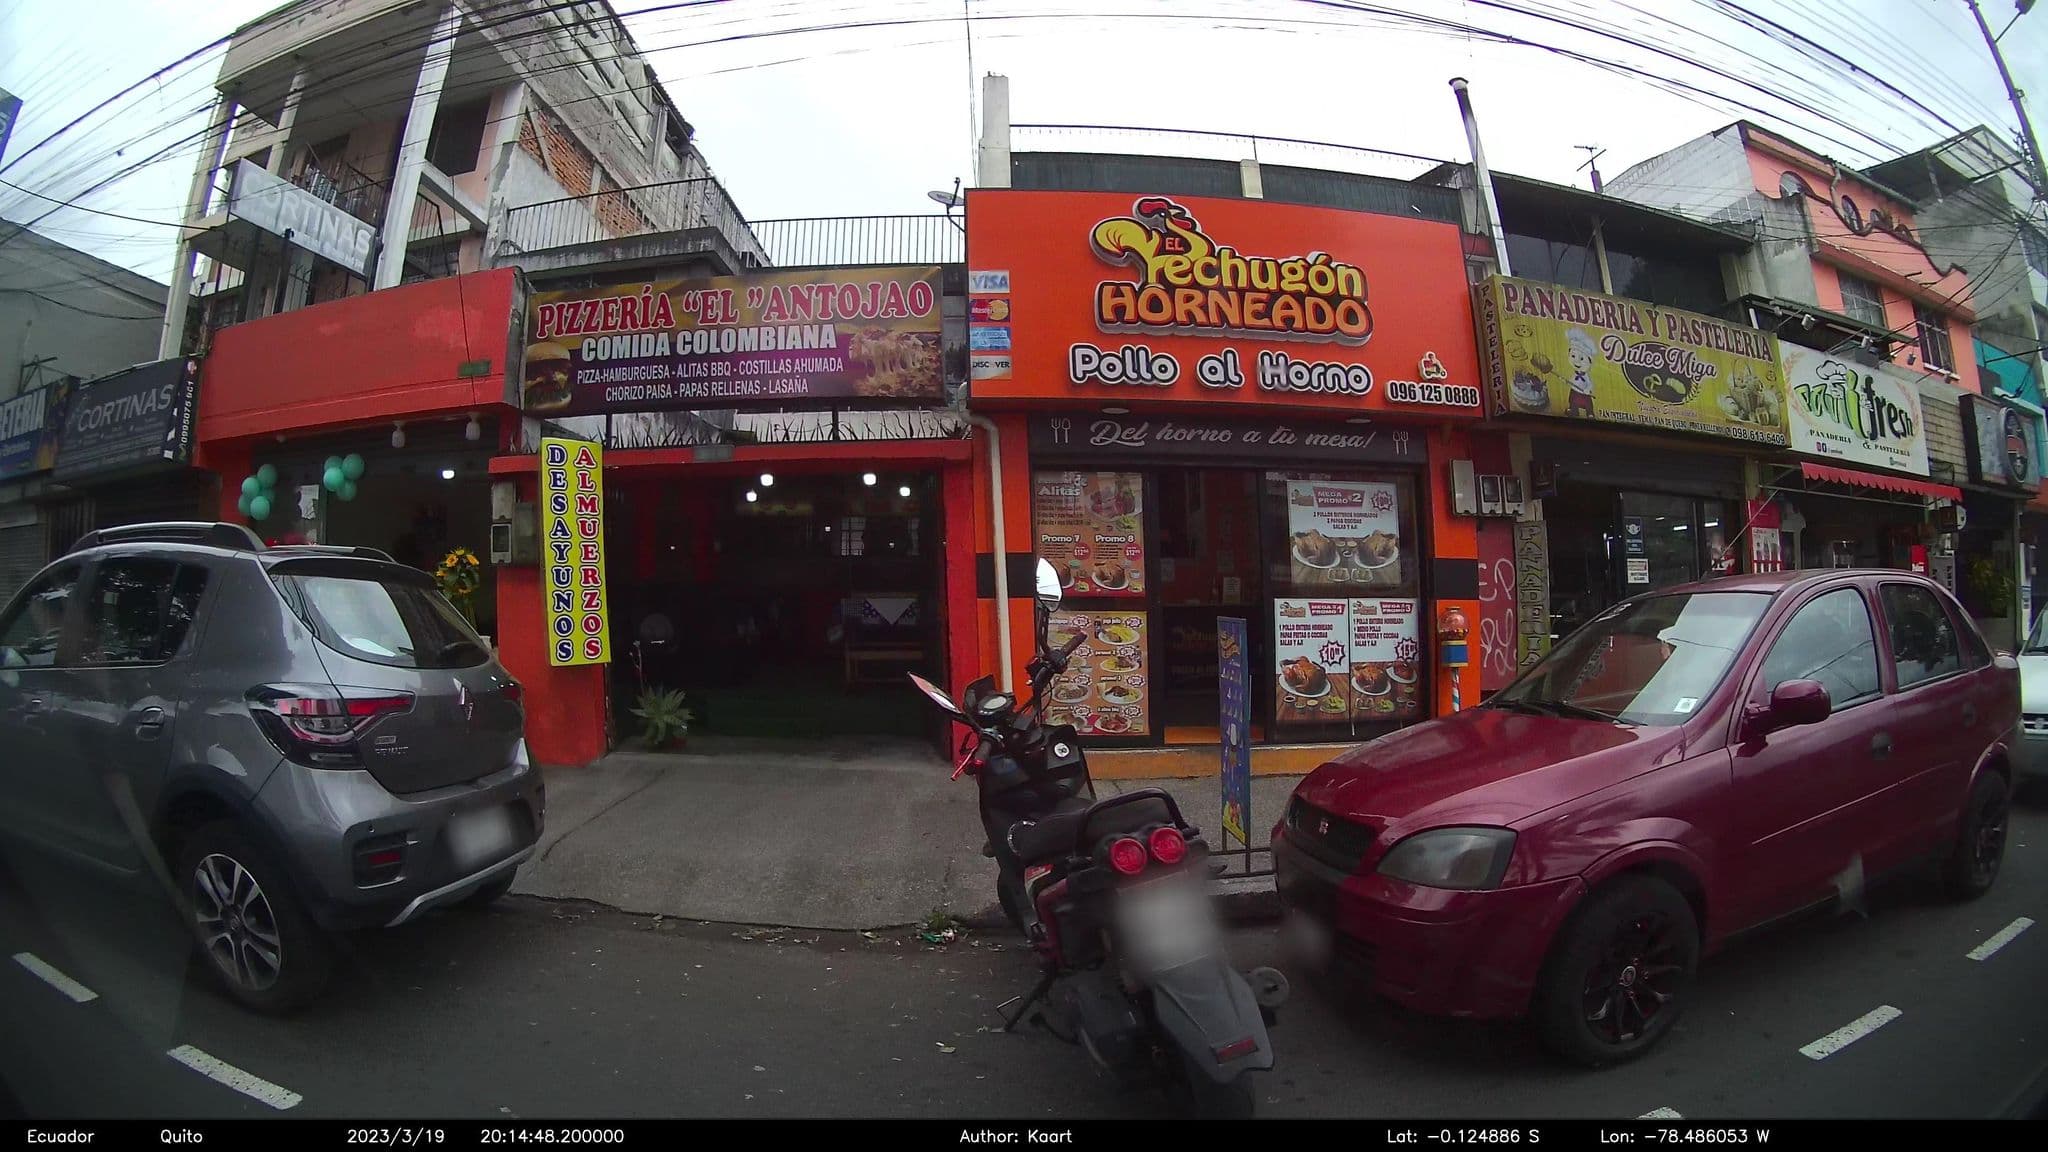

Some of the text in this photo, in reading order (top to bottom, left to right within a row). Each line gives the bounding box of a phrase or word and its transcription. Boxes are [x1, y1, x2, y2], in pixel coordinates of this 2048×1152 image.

[1165, 237, 1185, 251] EL
[971, 274, 1009, 289] VISA
[536, 284, 677, 338] PIZZERÍA
[1101, 284, 1369, 335] HORNEADO
[1501, 282, 1774, 363] PANADERIA Y PASTELERIA
[582, 324, 837, 361] COMIDA COLOMBIANA
[1480, 285, 1507, 415] PASTELERIA
[577, 365, 670, 384] PIZZA-HAMBURGUESA
[676, 362, 708, 378] ALITAS
[710, 361, 731, 377] BBQ
[739, 359, 791, 375] COSTILLAS
[794, 357, 843, 373] AHUMADA
[1072, 344, 1372, 393] Pollo al Horno
[1601, 335, 1718, 381] Dulce Miga
[606, 385, 644, 401] CHORIZO
[648, 383, 672, 399] PAISA
[679, 381, 708, 397] PAPAS
[711, 379, 760, 395] RELLENAS
[769, 375, 808, 394] LASAÑA
[1389, 383, 1478, 405] 096 125 0888
[77, 383, 175, 432] CORTINAS
[1090, 421, 1149, 446] Del
[1156, 422, 1232, 442] horno
[1243, 428, 1261, 443] a
[1732, 427, 1748, 438] 098
[1750, 430, 1765, 442] 613
[1766, 433, 1785, 445] 6409
[1810, 429, 1852, 444] PANADERIA
[1039, 486, 1080, 496] Alitas
[1352, 493, 1362, 502] 2
[547, 444, 574, 662] DESAYUNOS
[574, 446, 602, 659] ALMUERZOS
[1405, 604, 1411, 612] 3
